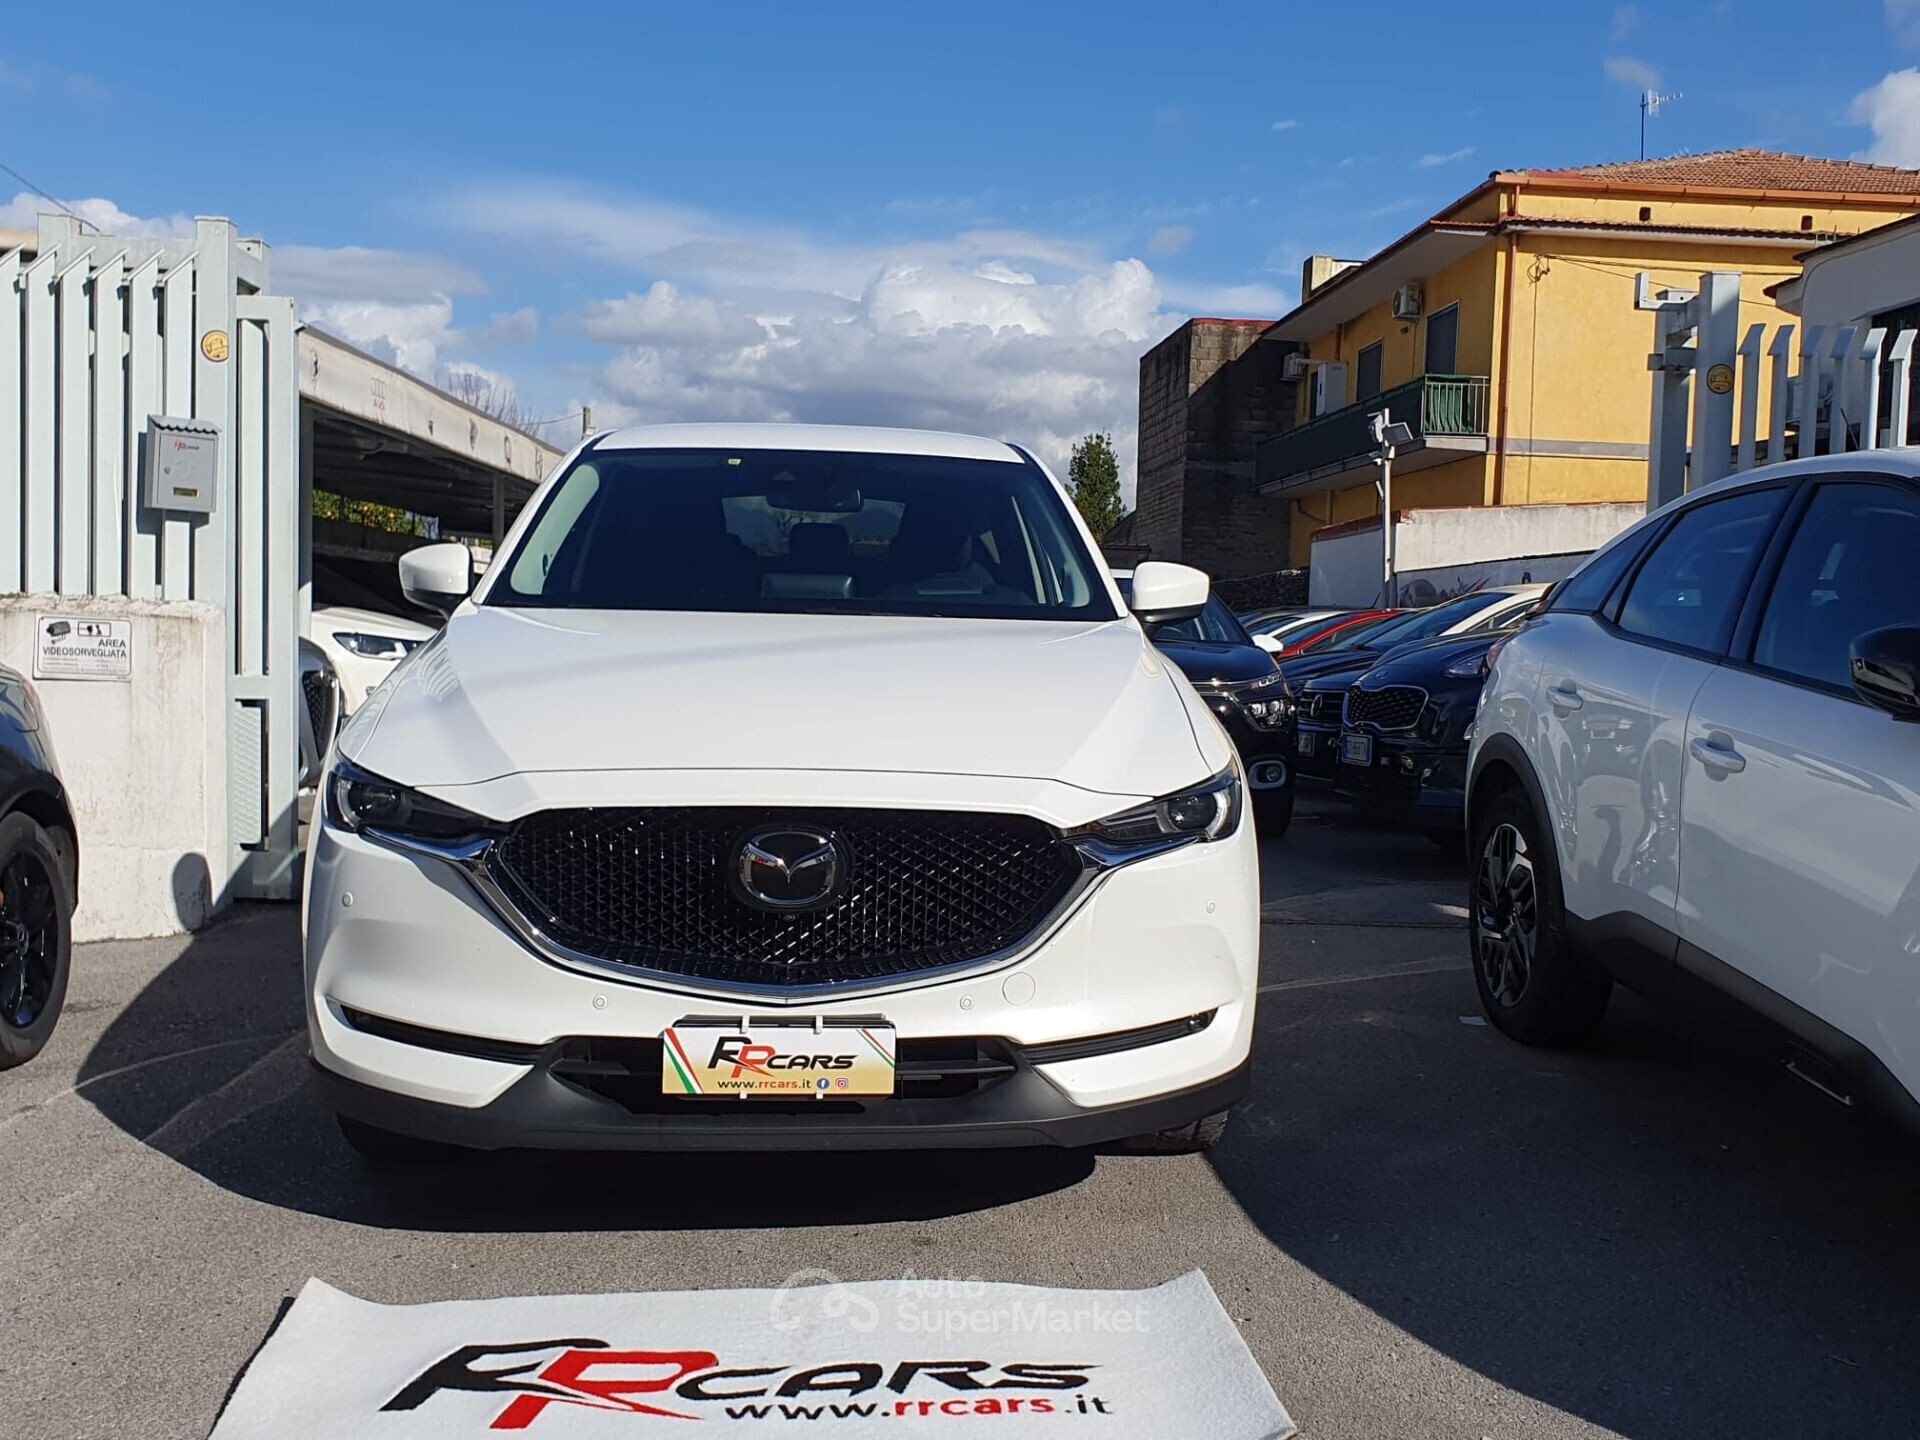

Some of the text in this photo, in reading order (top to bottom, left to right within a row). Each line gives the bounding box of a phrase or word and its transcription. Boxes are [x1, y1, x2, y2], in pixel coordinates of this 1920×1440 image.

[98, 638, 127, 648] AREA
[42, 646, 127, 658] VIDEOSORVEGLIATA
[717, 1079, 812, 1089] www.rrcars.it
[725, 1394, 1113, 1421] www.rrcars.it
